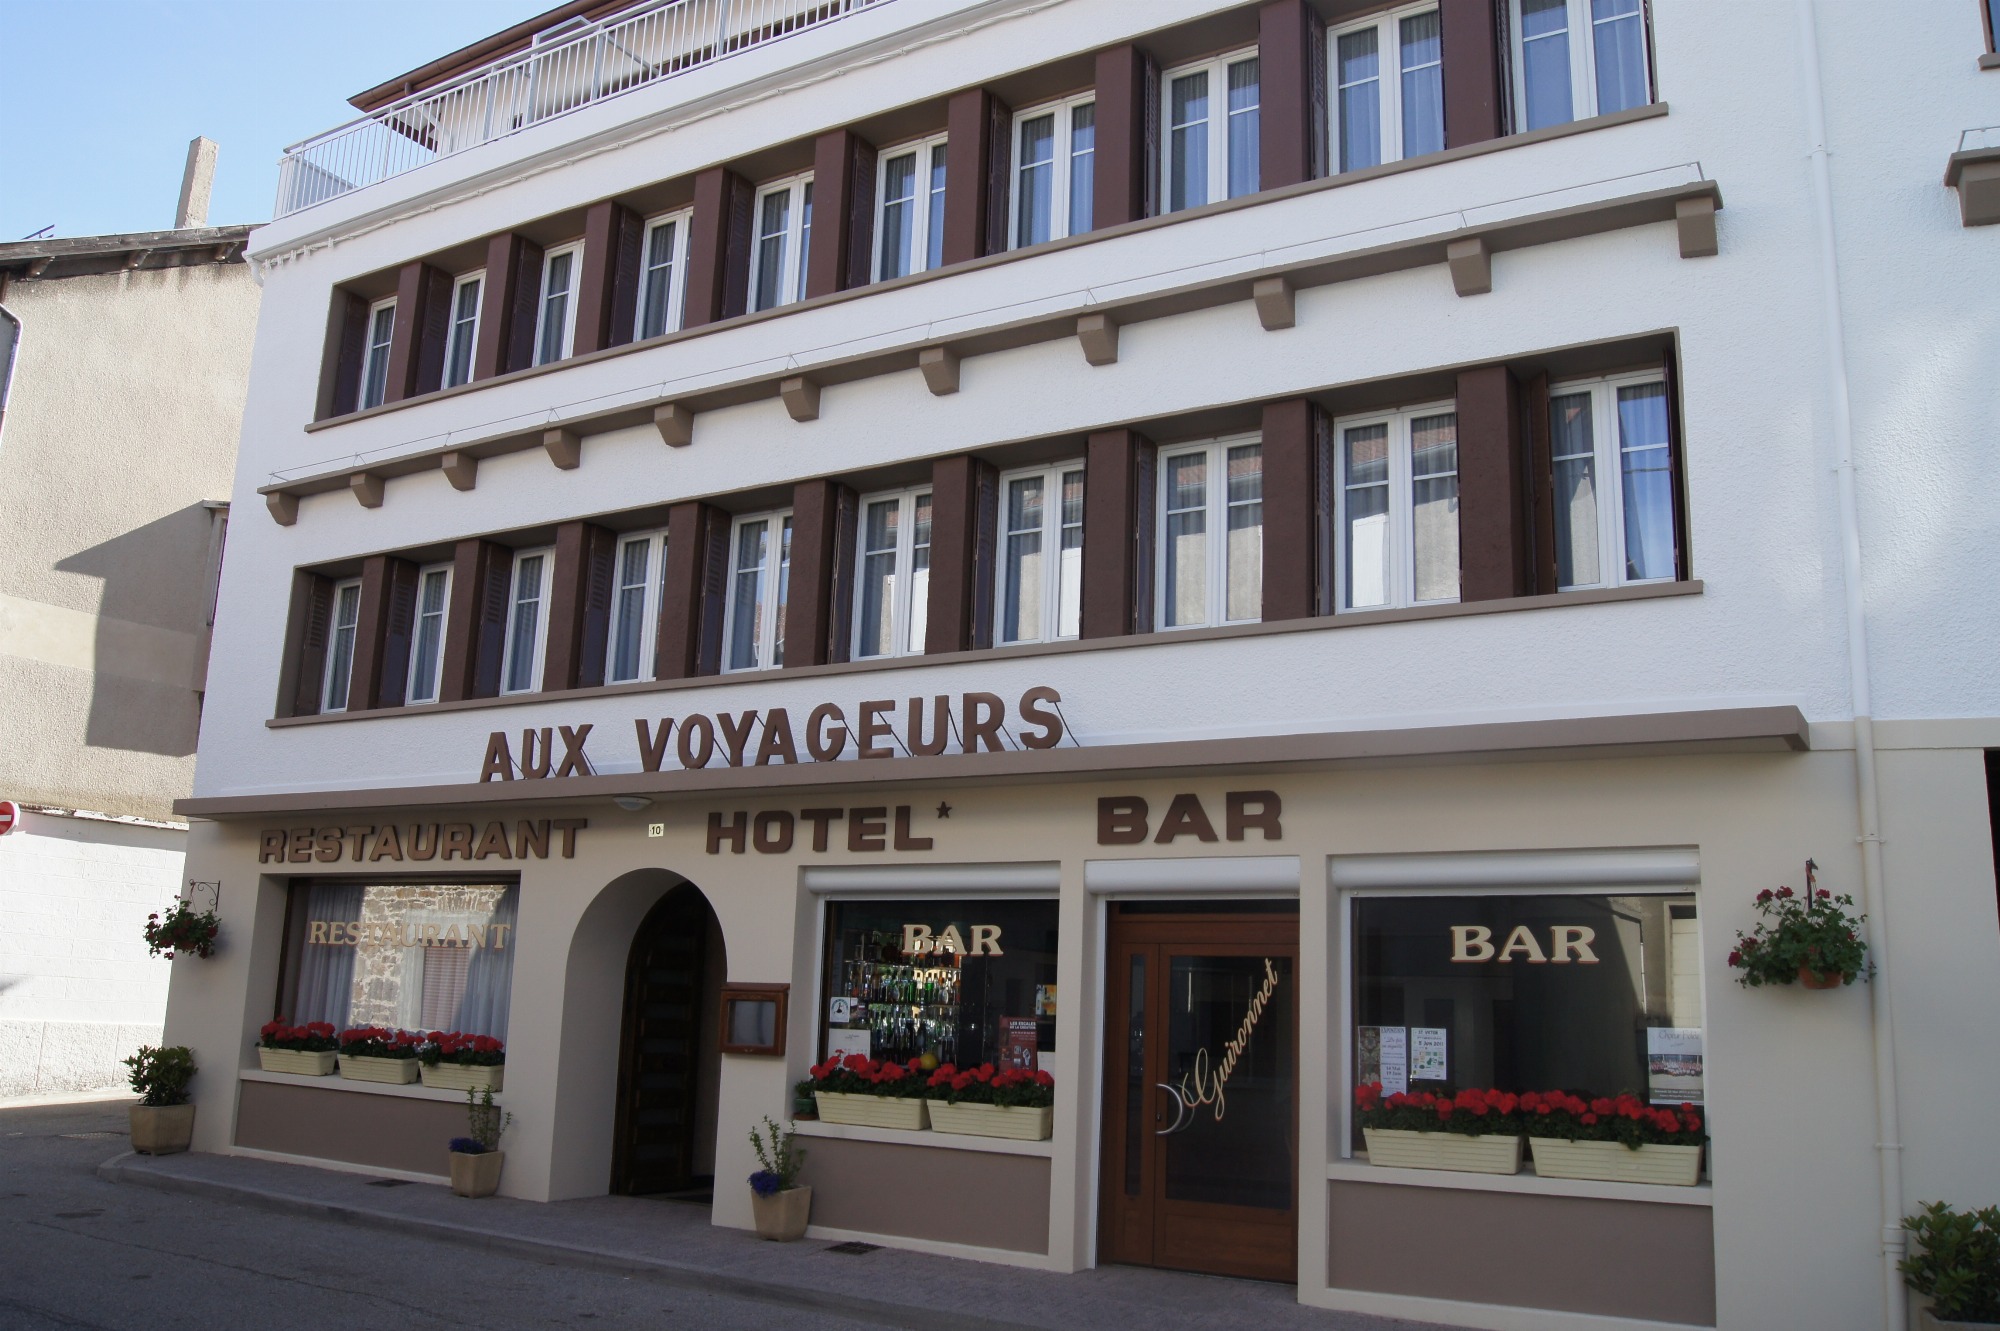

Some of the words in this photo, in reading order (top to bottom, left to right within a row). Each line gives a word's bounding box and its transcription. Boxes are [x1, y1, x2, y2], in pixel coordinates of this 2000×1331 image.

[480, 724, 594, 783] AUX
[635, 686, 1064, 773] VOYAGEURS
[652, 825, 661, 835] 10
[706, 805, 934, 855] HOTEL
[1097, 790, 1283, 845] BAR
[258, 818, 588, 864] RESTAURANT
[308, 920, 511, 950] RESTAURANT
[901, 924, 1004, 956] BAR
[1450, 925, 1600, 964] BAR
[1181, 957, 1279, 1122] Guironnet
